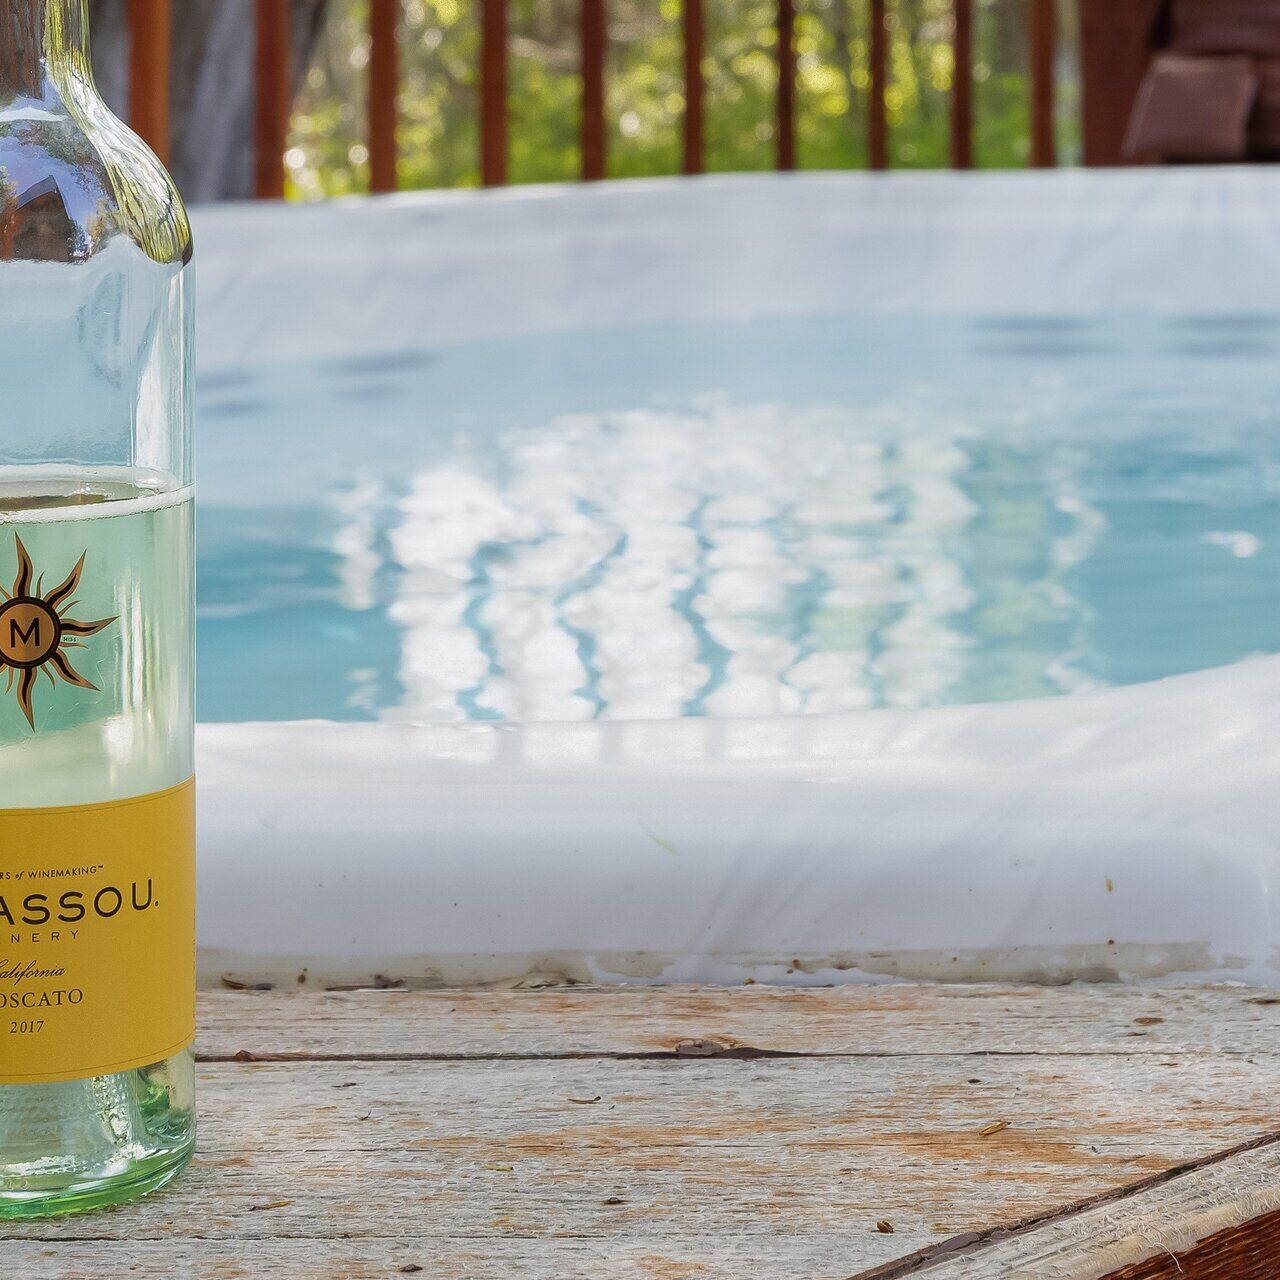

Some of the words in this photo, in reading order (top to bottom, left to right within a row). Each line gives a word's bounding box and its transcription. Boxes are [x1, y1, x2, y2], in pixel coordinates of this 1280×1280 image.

[9, 617, 40, 648] M
[14, 870, 25, 881] of
[9, 1019, 45, 1034] 2017
